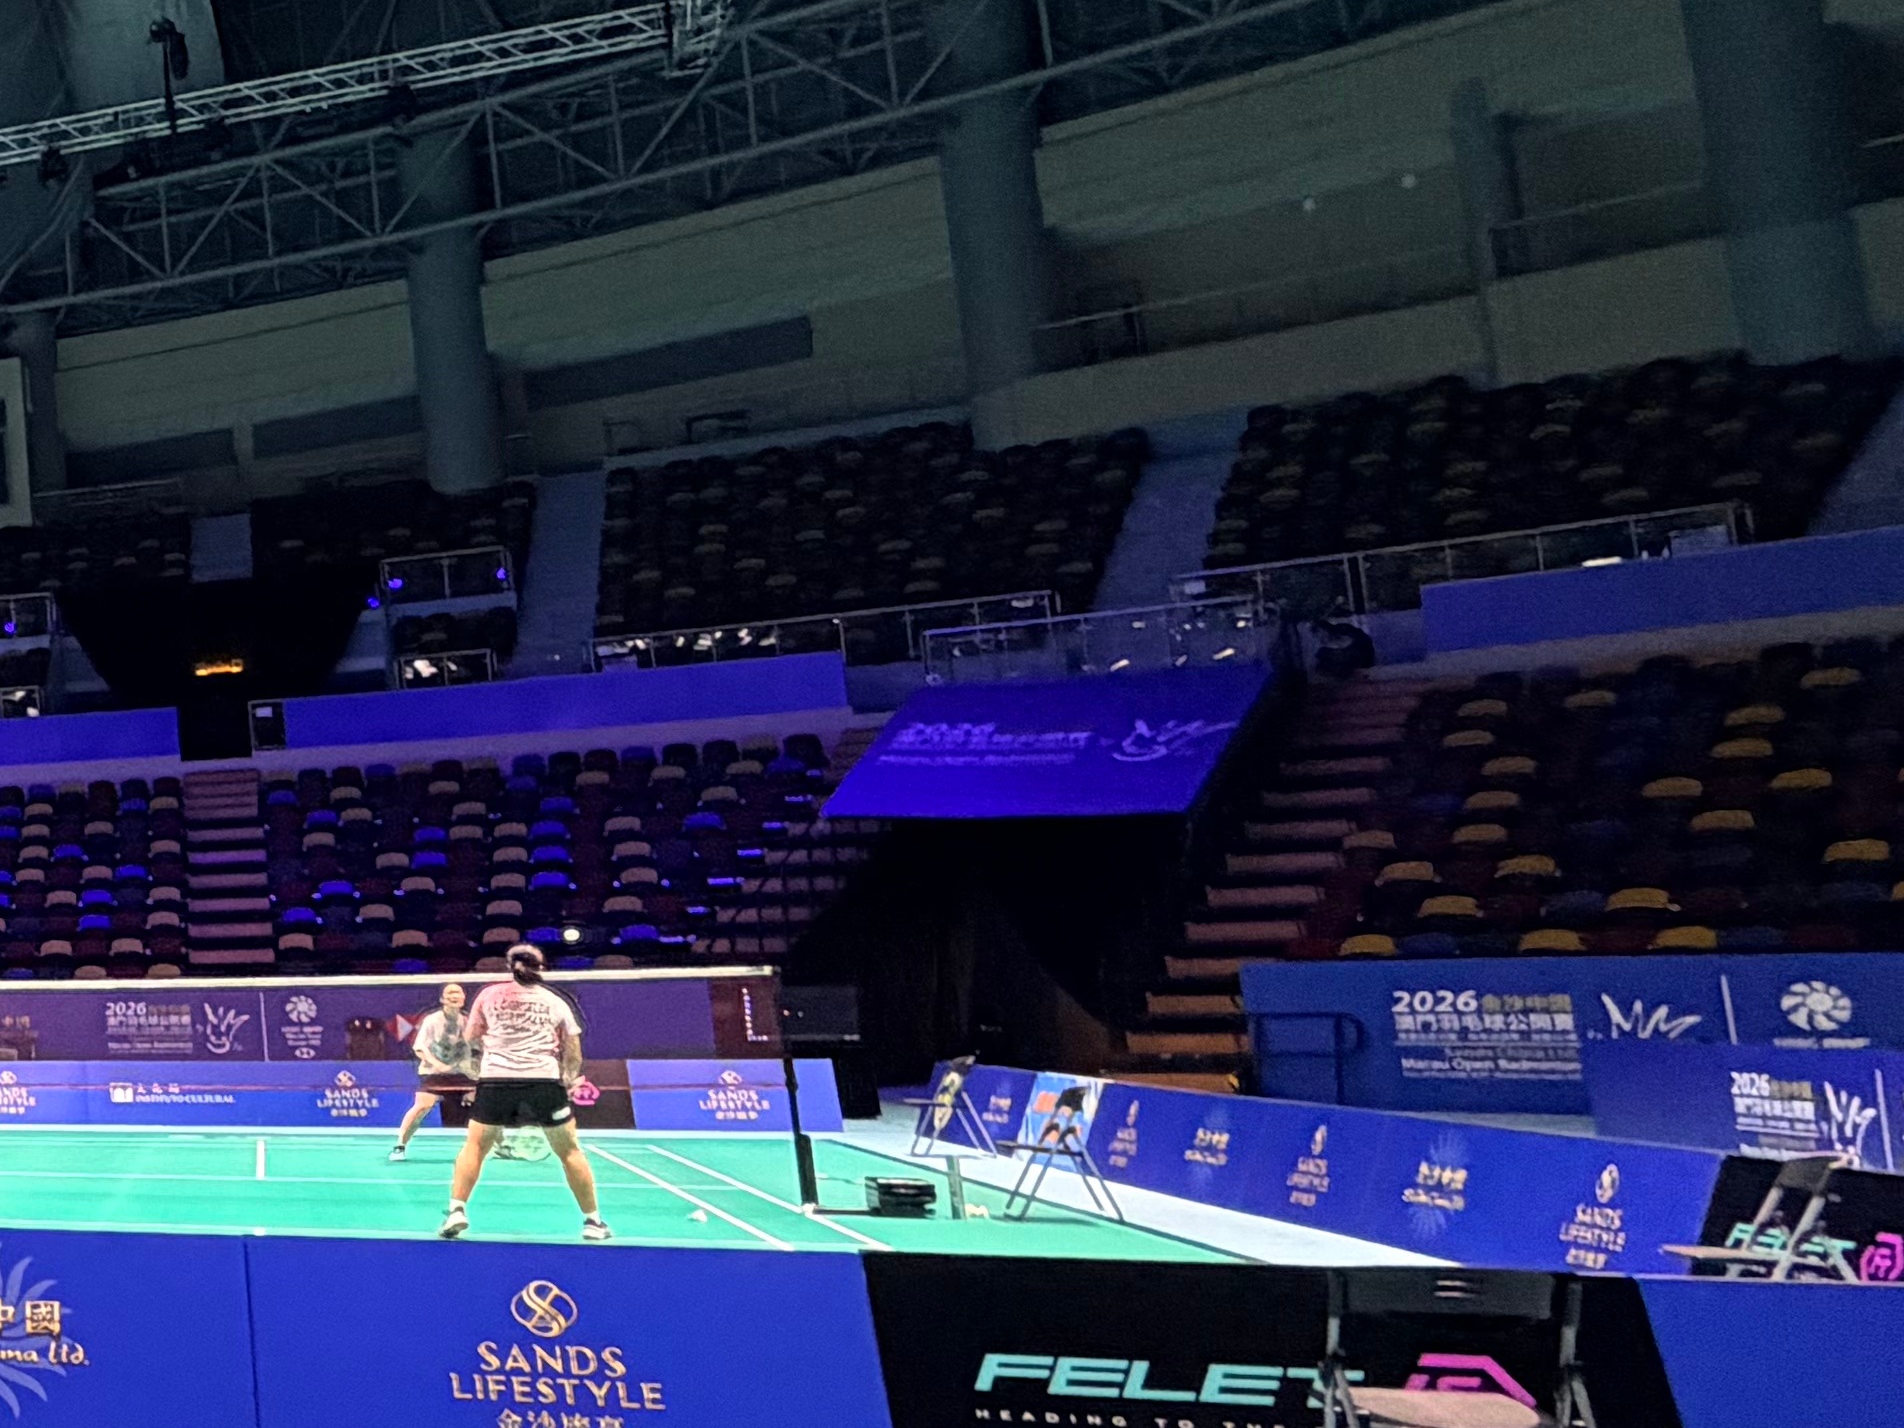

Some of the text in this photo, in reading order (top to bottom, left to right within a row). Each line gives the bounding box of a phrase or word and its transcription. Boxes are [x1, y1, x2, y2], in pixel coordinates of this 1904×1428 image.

[105, 1002, 147, 1016] 2026
[1392, 990, 1478, 1012] 2026
[324, 1088, 369, 1099] SANDS
[1730, 1071, 1770, 1096] 2026
[316, 1098, 380, 1109] LIFESTYLE
[698, 1099, 771, 1111] LIFESTYLE
[708, 1089, 759, 1101] SANDS
[476, 1340, 627, 1378] SANDS
[974, 1352, 1365, 1409] FELET
[449, 1372, 667, 1410] LIFESTYLE
[974, 1408, 1127, 1428] HEADING
